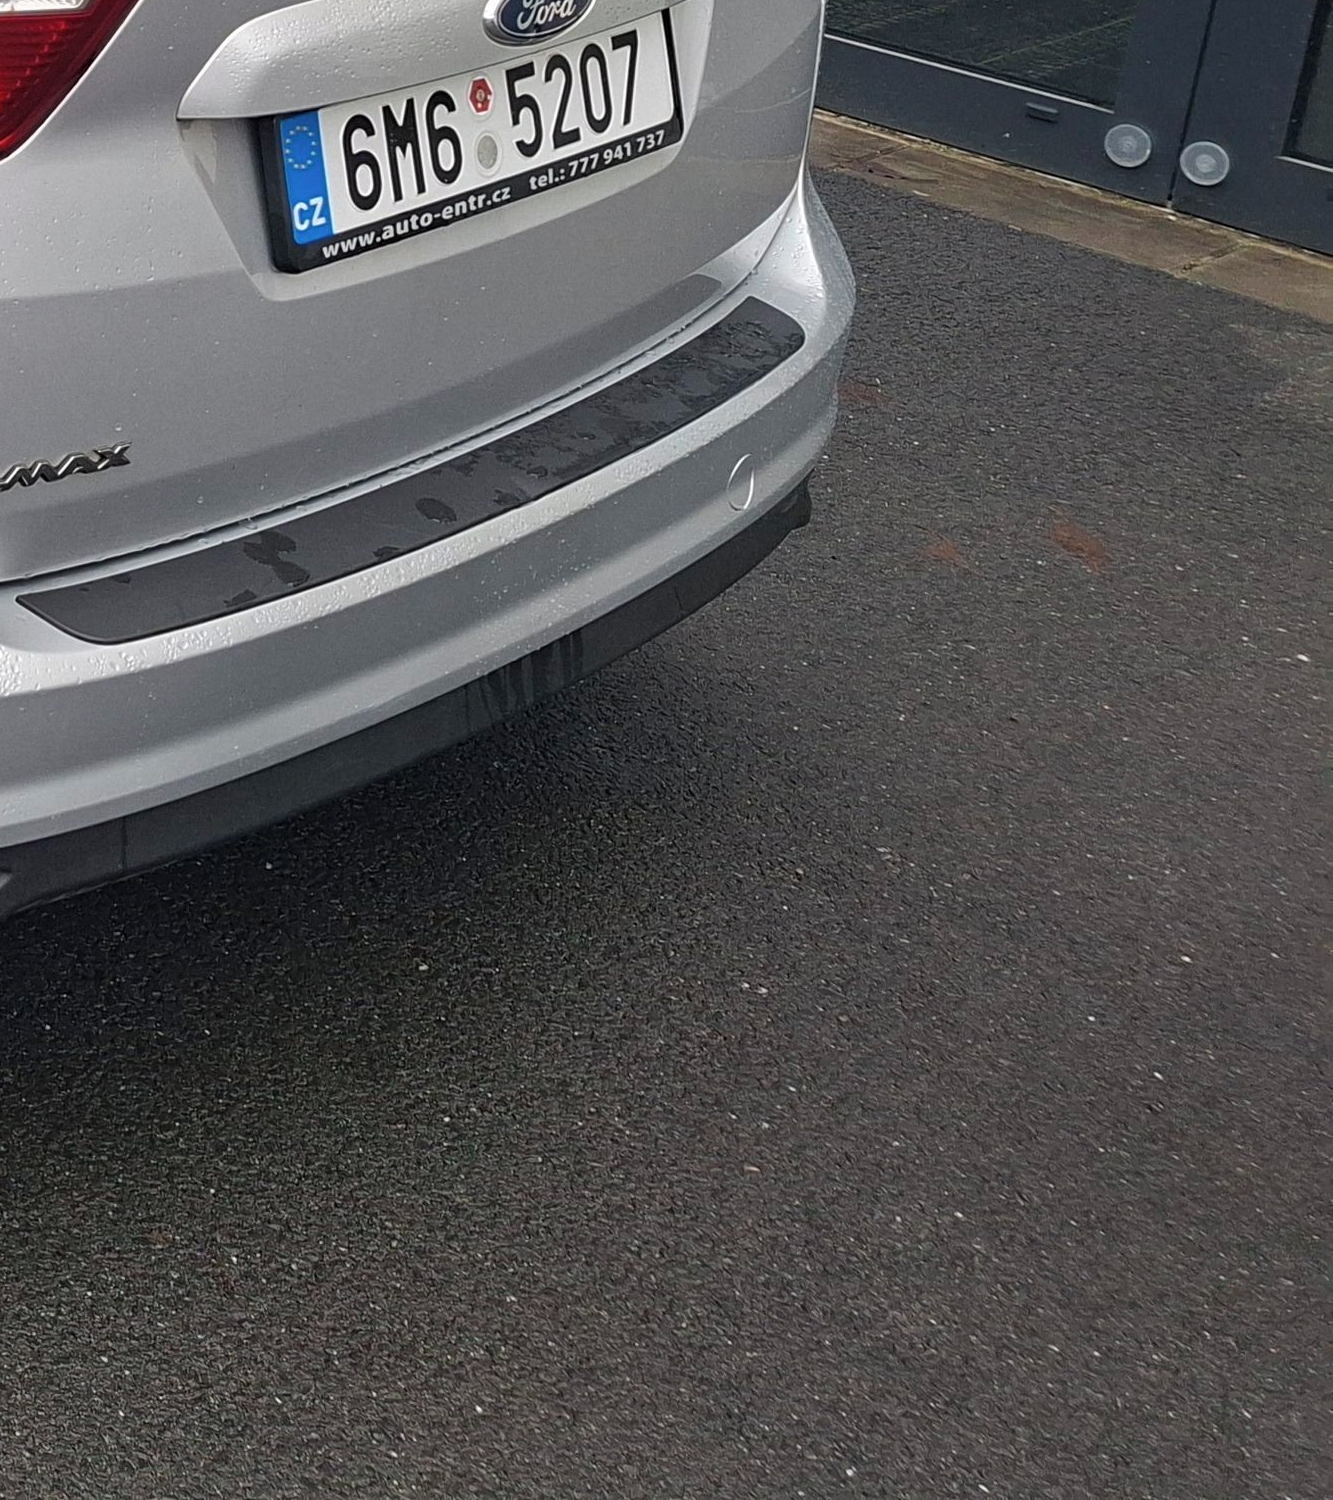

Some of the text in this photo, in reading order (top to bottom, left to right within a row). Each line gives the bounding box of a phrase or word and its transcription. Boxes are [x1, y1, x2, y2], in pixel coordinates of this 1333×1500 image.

[341, 30, 639, 212] 6M6 5207
[293, 196, 327, 232] CZ
[322, 130, 666, 259] www.auto-entr.cz tel.: 777 941 737
